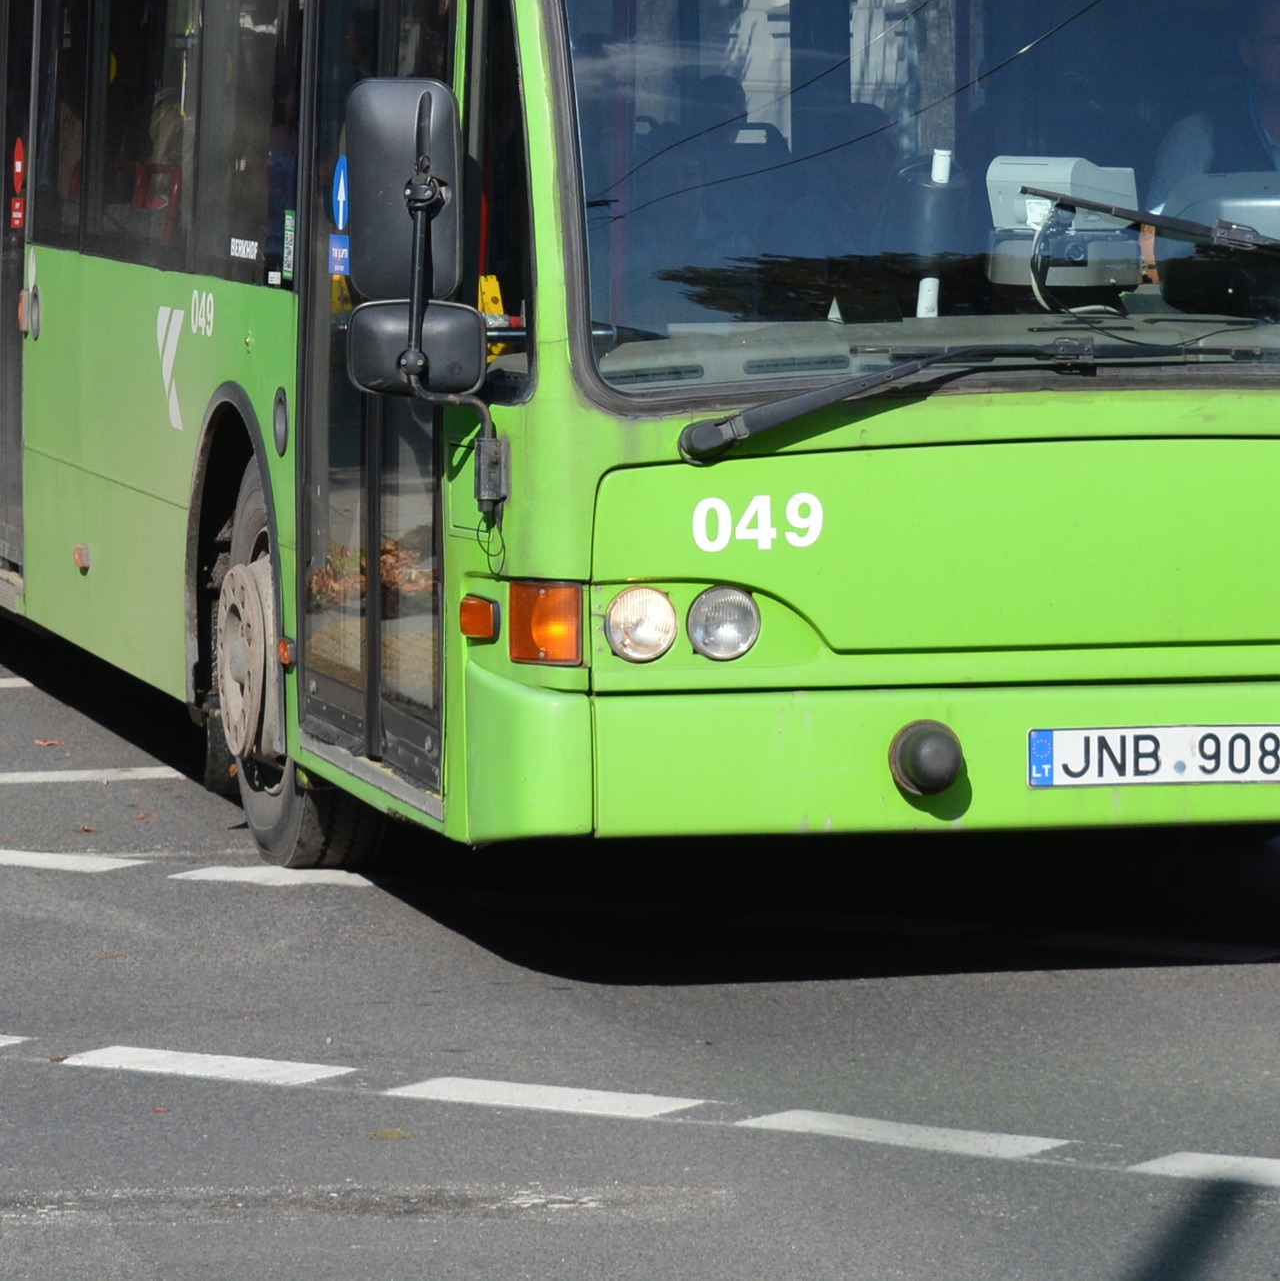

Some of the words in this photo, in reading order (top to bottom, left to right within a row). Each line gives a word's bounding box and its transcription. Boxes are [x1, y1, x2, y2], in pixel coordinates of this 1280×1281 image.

[230, 237, 258, 260] BERKHOF
[191, 289, 214, 337] 049
[691, 492, 824, 552] 049
[1032, 765, 1051, 777] LT
[1061, 734, 1161, 778] JNB
[1198, 732, 1280, 774] 908
